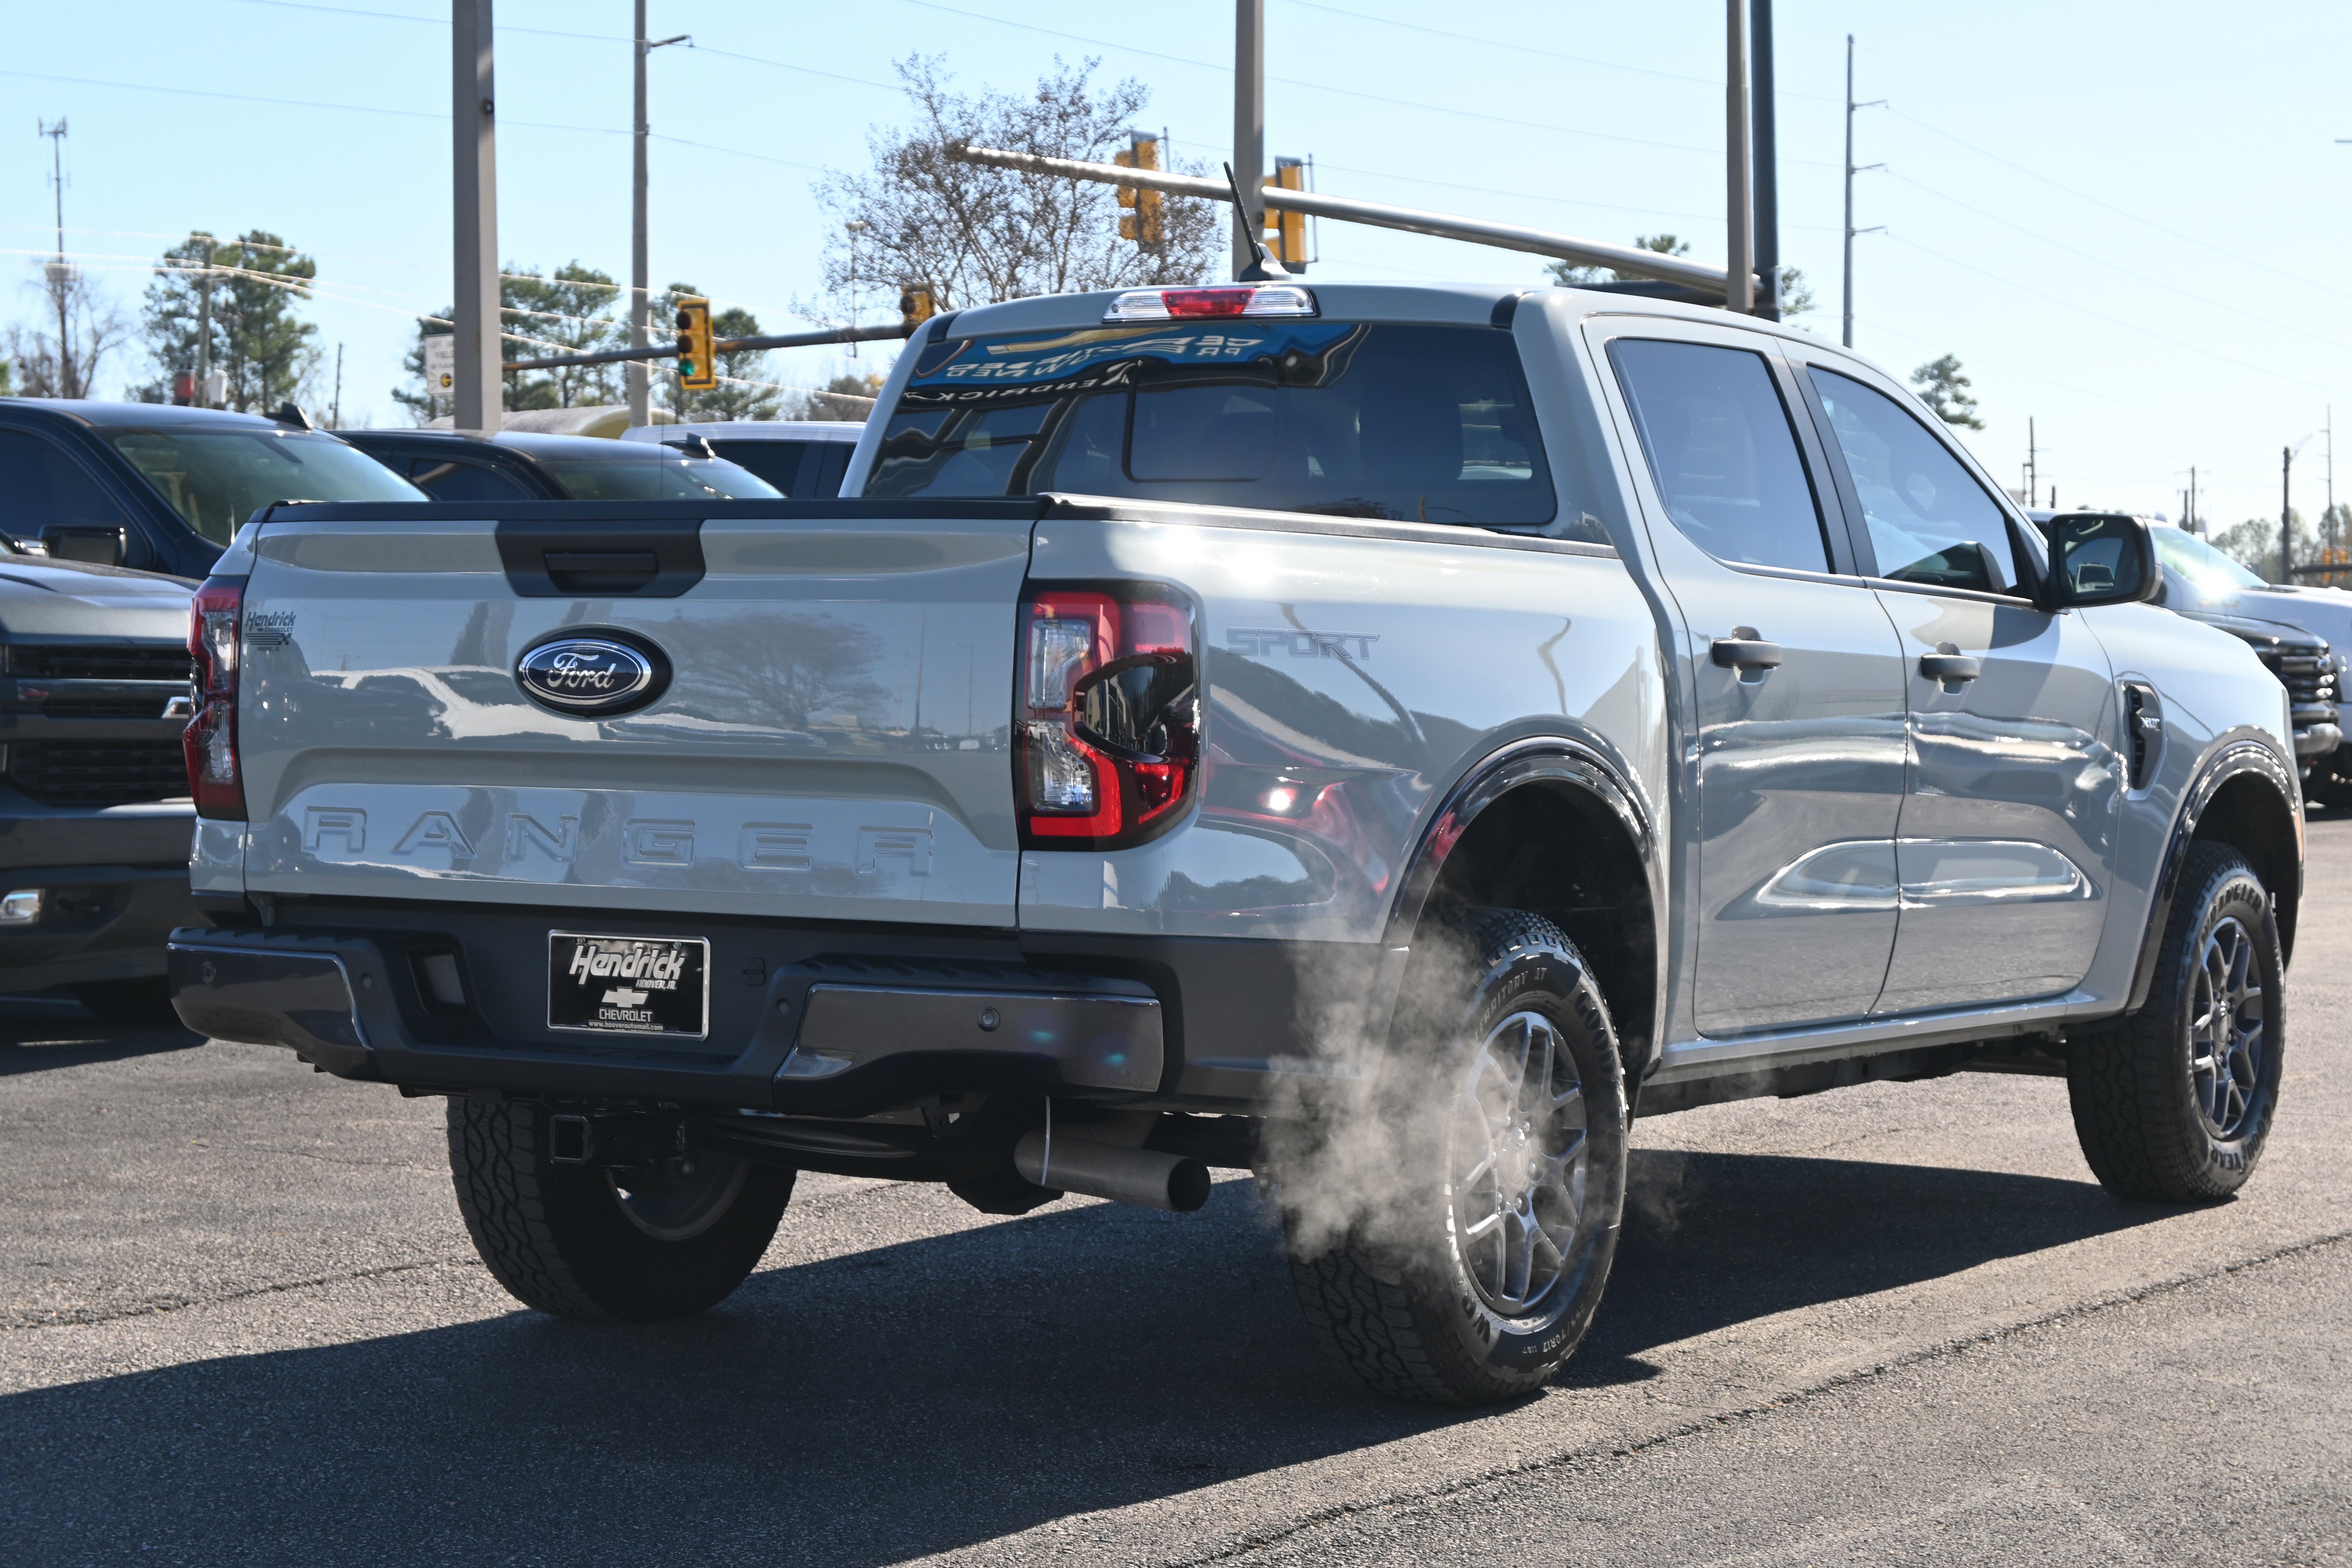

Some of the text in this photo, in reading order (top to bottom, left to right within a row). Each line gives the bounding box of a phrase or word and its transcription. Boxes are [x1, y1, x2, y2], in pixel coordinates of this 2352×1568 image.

[245, 611, 296, 631] Hendrick
[1227, 627, 1380, 659] SPORT
[546, 652, 617, 688] Ford
[2140, 717, 2161, 728] XLT
[301, 806, 933, 876] RANGER
[2201, 883, 2262, 942] WRANGLER
[569, 945, 686, 985] Hendrick
[599, 1009, 652, 1022] CHEVROLET
[1474, 967, 1548, 1042] TERRITORY AT
[588, 1020, 663, 1031] www.hooverautomall.com
